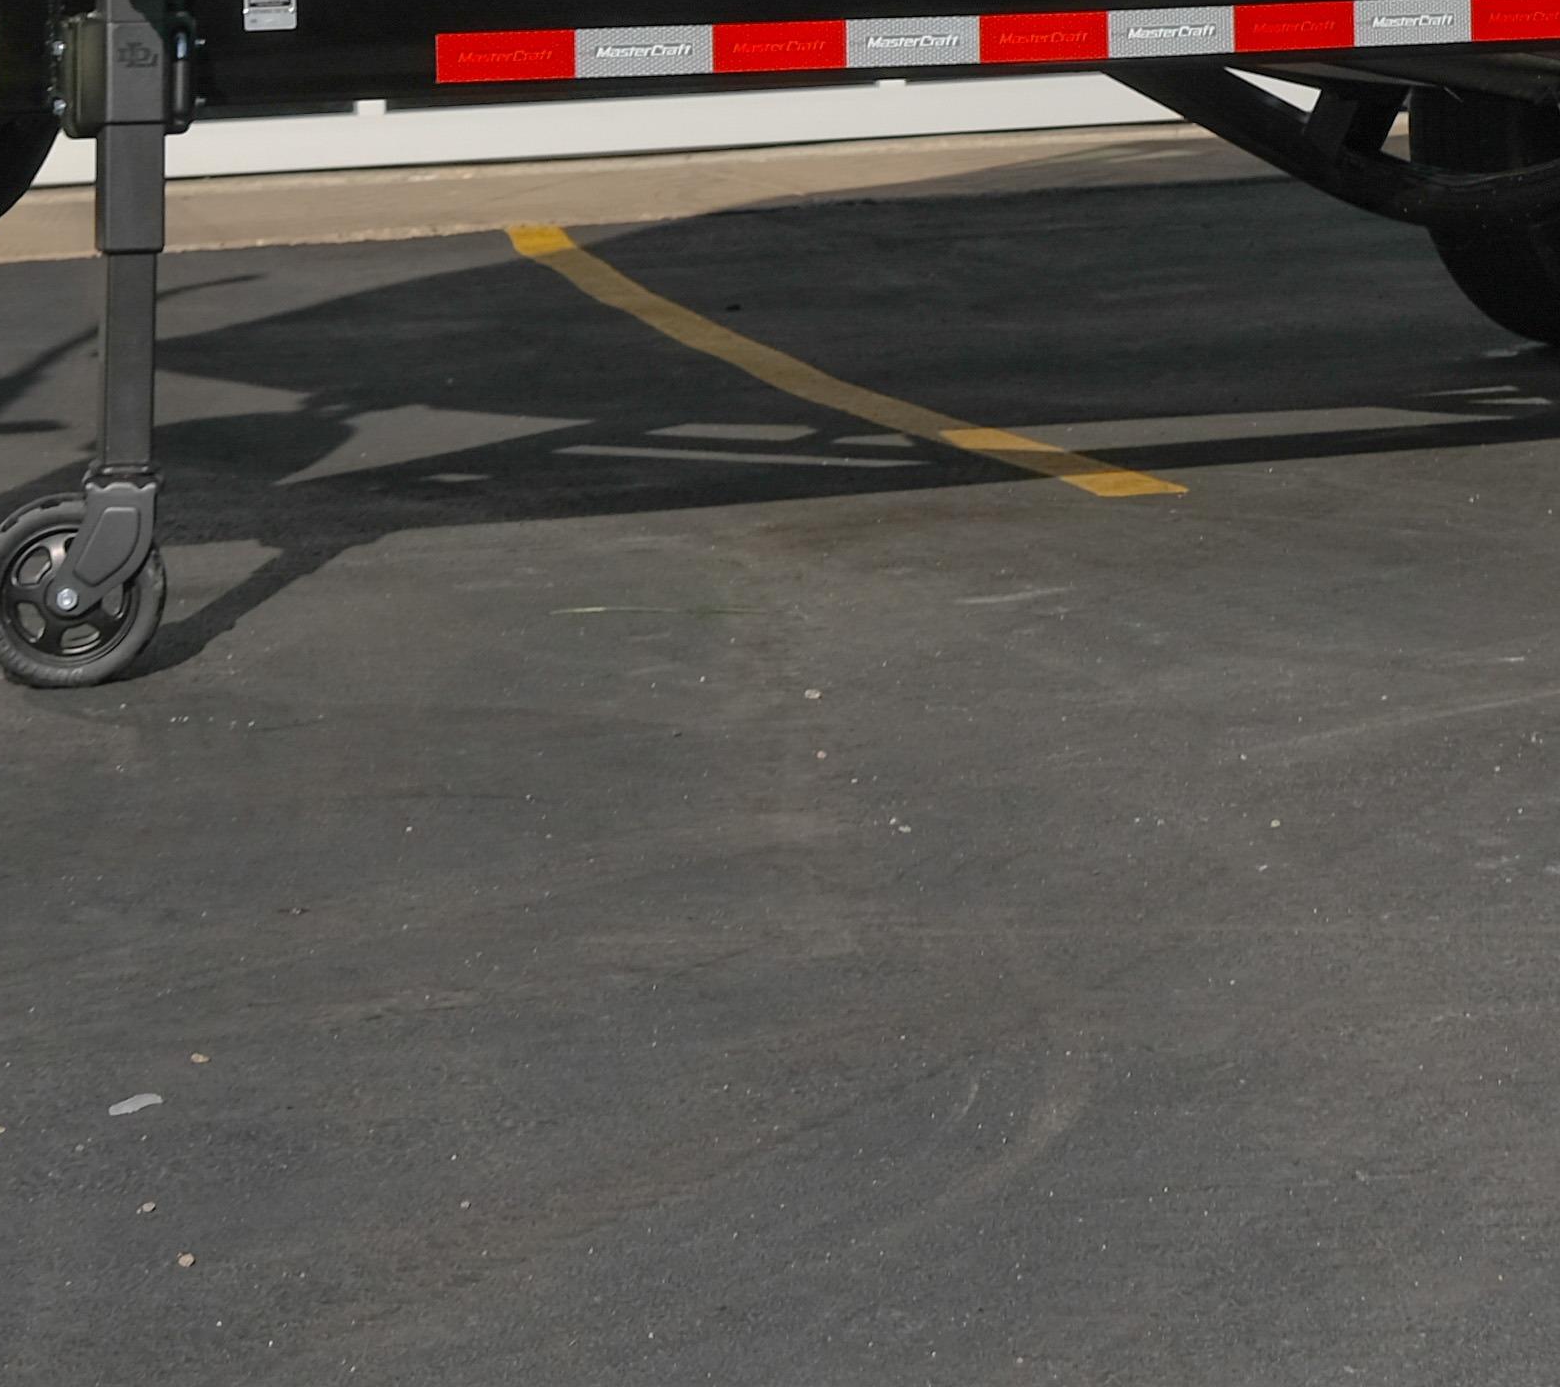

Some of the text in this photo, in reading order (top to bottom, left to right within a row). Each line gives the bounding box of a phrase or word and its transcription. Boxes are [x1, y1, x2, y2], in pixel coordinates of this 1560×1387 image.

[596, 43, 693, 60] MasterCraft
[867, 33, 960, 50] MasterCraft
[1127, 24, 1217, 40] MasterCraft
[1371, 13, 1455, 29] MasterCraft
